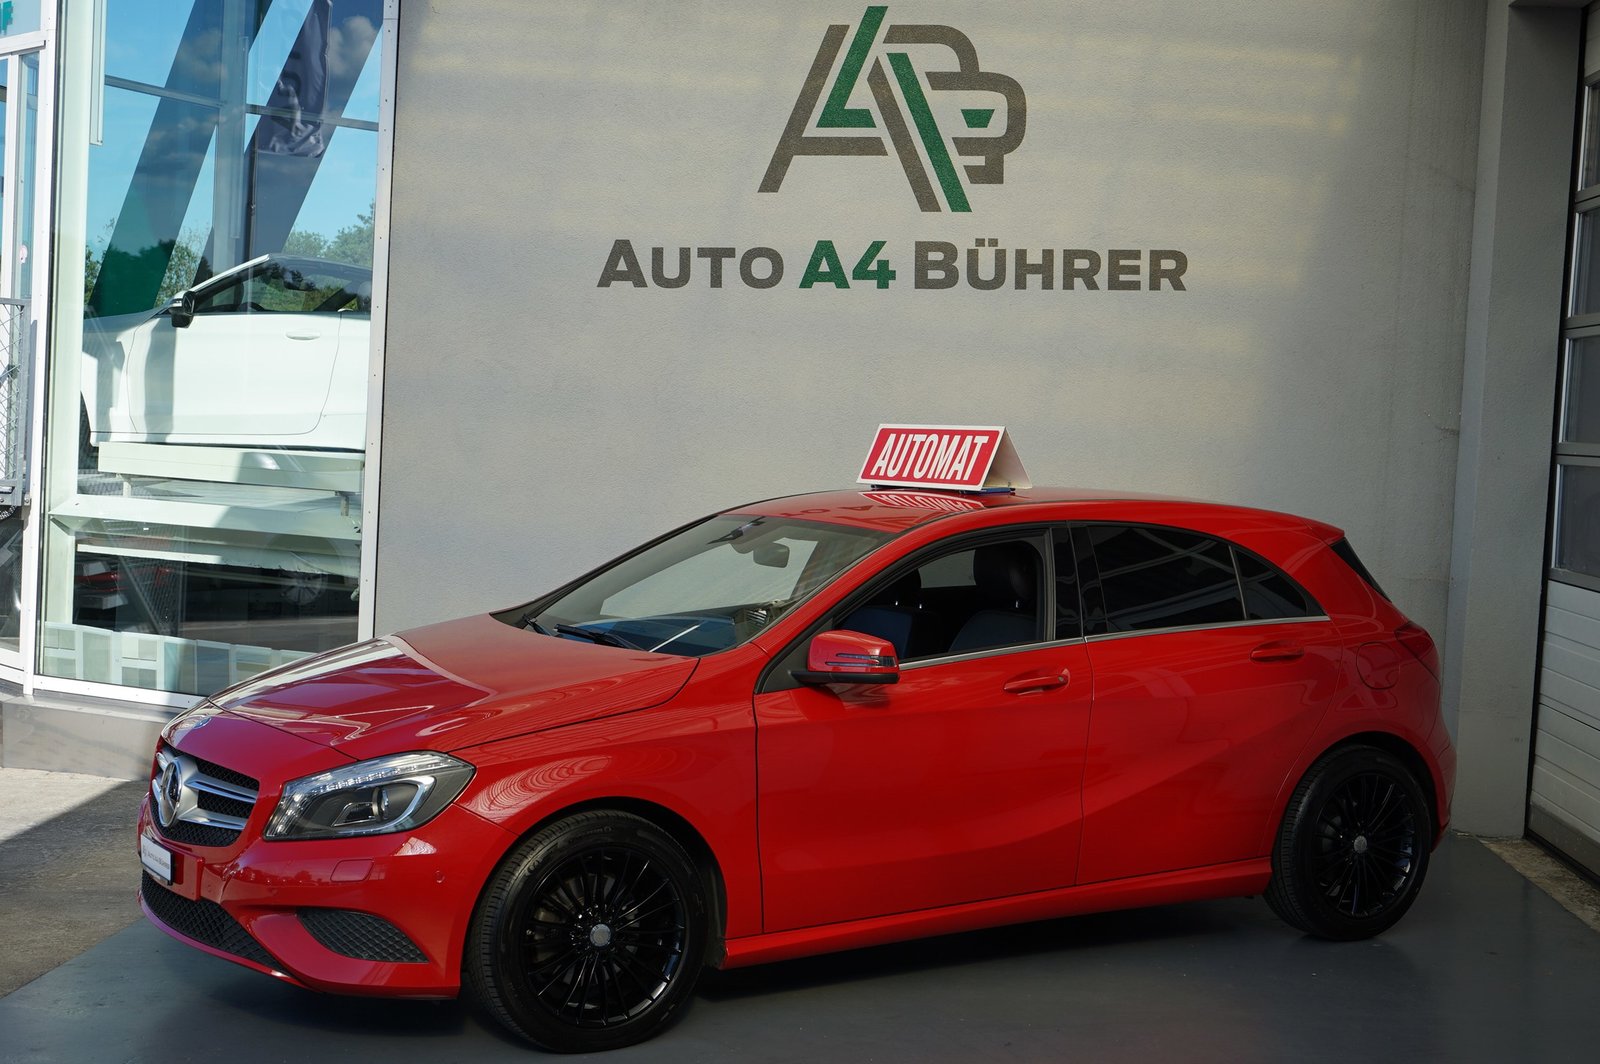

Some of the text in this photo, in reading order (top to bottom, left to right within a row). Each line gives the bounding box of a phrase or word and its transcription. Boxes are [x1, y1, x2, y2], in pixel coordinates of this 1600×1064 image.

[597, 238, 1188, 291] AUTO A4 BÜHRER
[870, 433, 990, 481] AUTOMAT
